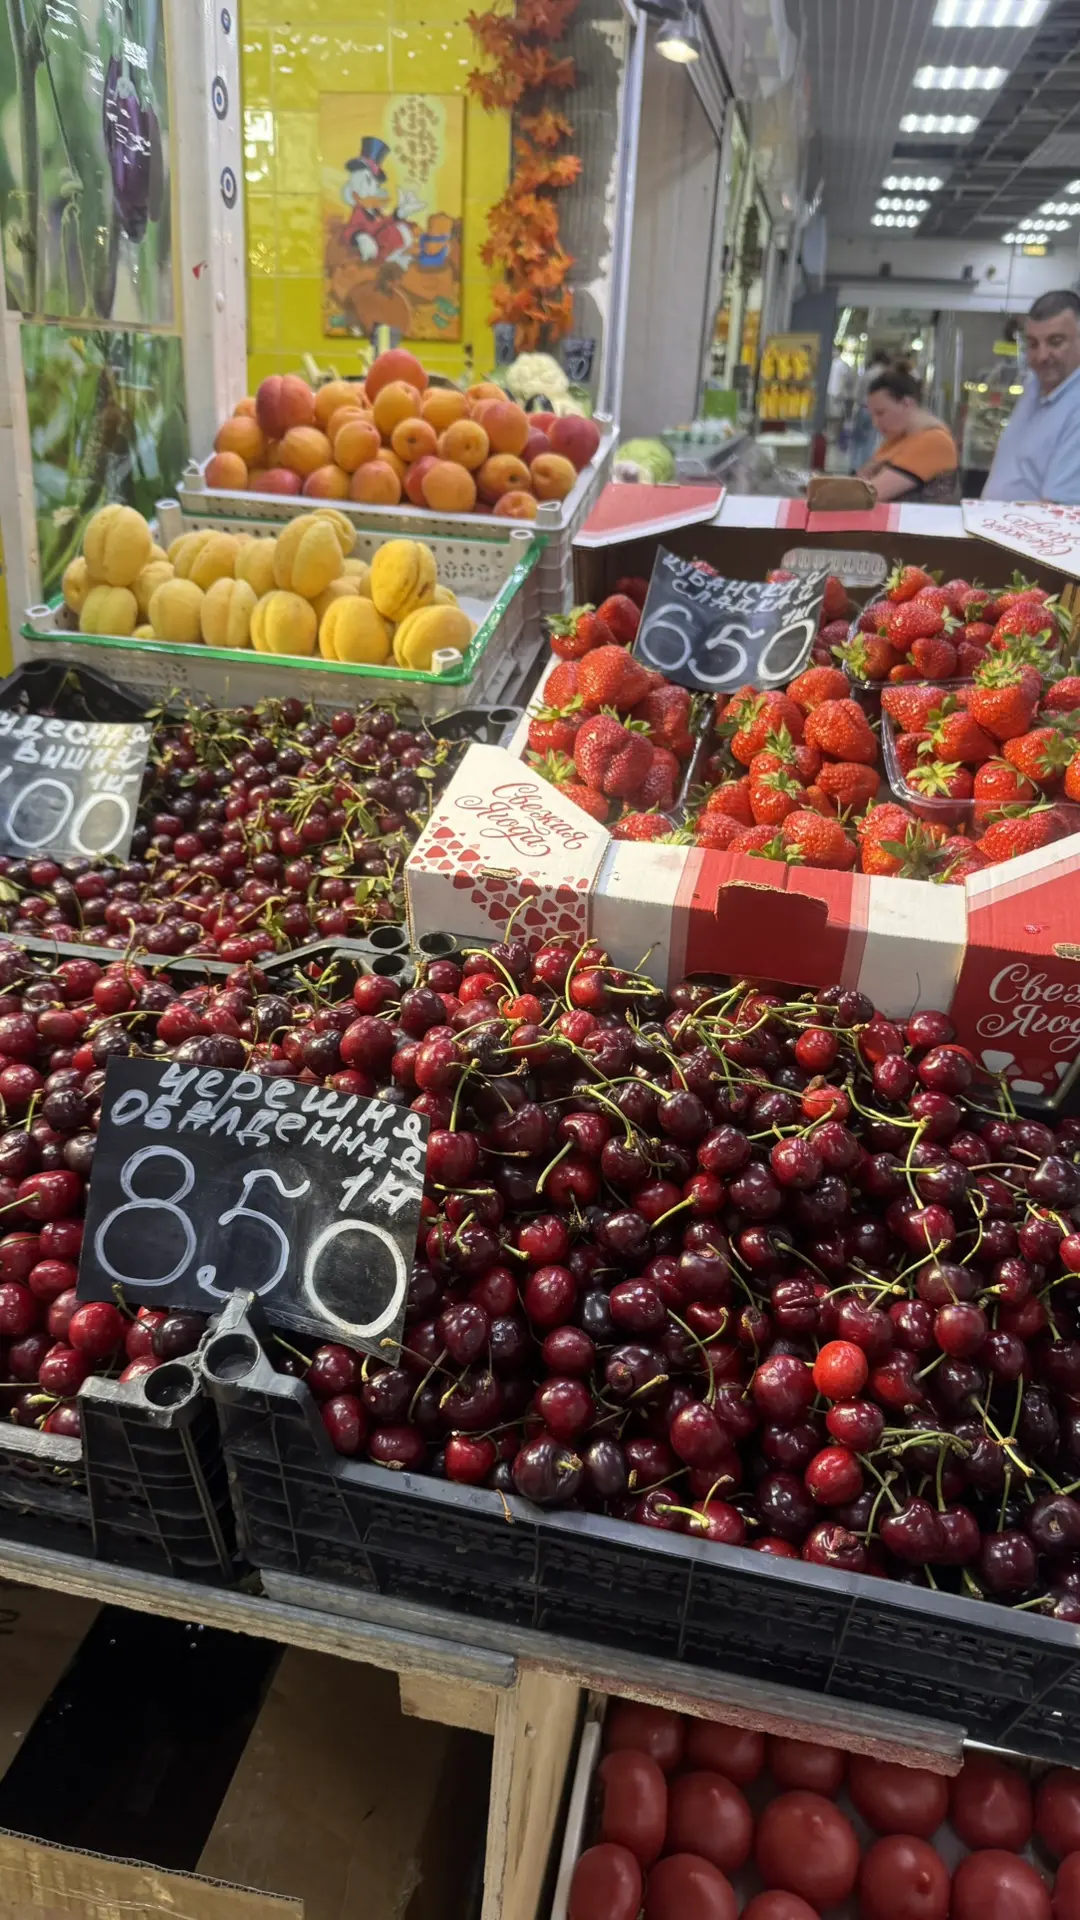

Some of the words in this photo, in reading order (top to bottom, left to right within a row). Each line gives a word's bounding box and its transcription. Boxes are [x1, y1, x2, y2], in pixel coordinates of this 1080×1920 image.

[640, 603, 815, 684] 650
[0, 766, 130, 856] 00
[455, 796, 551, 857] Ягода
[492, 783, 588, 850] Свежая
[94, 1145, 407, 1338] 850
